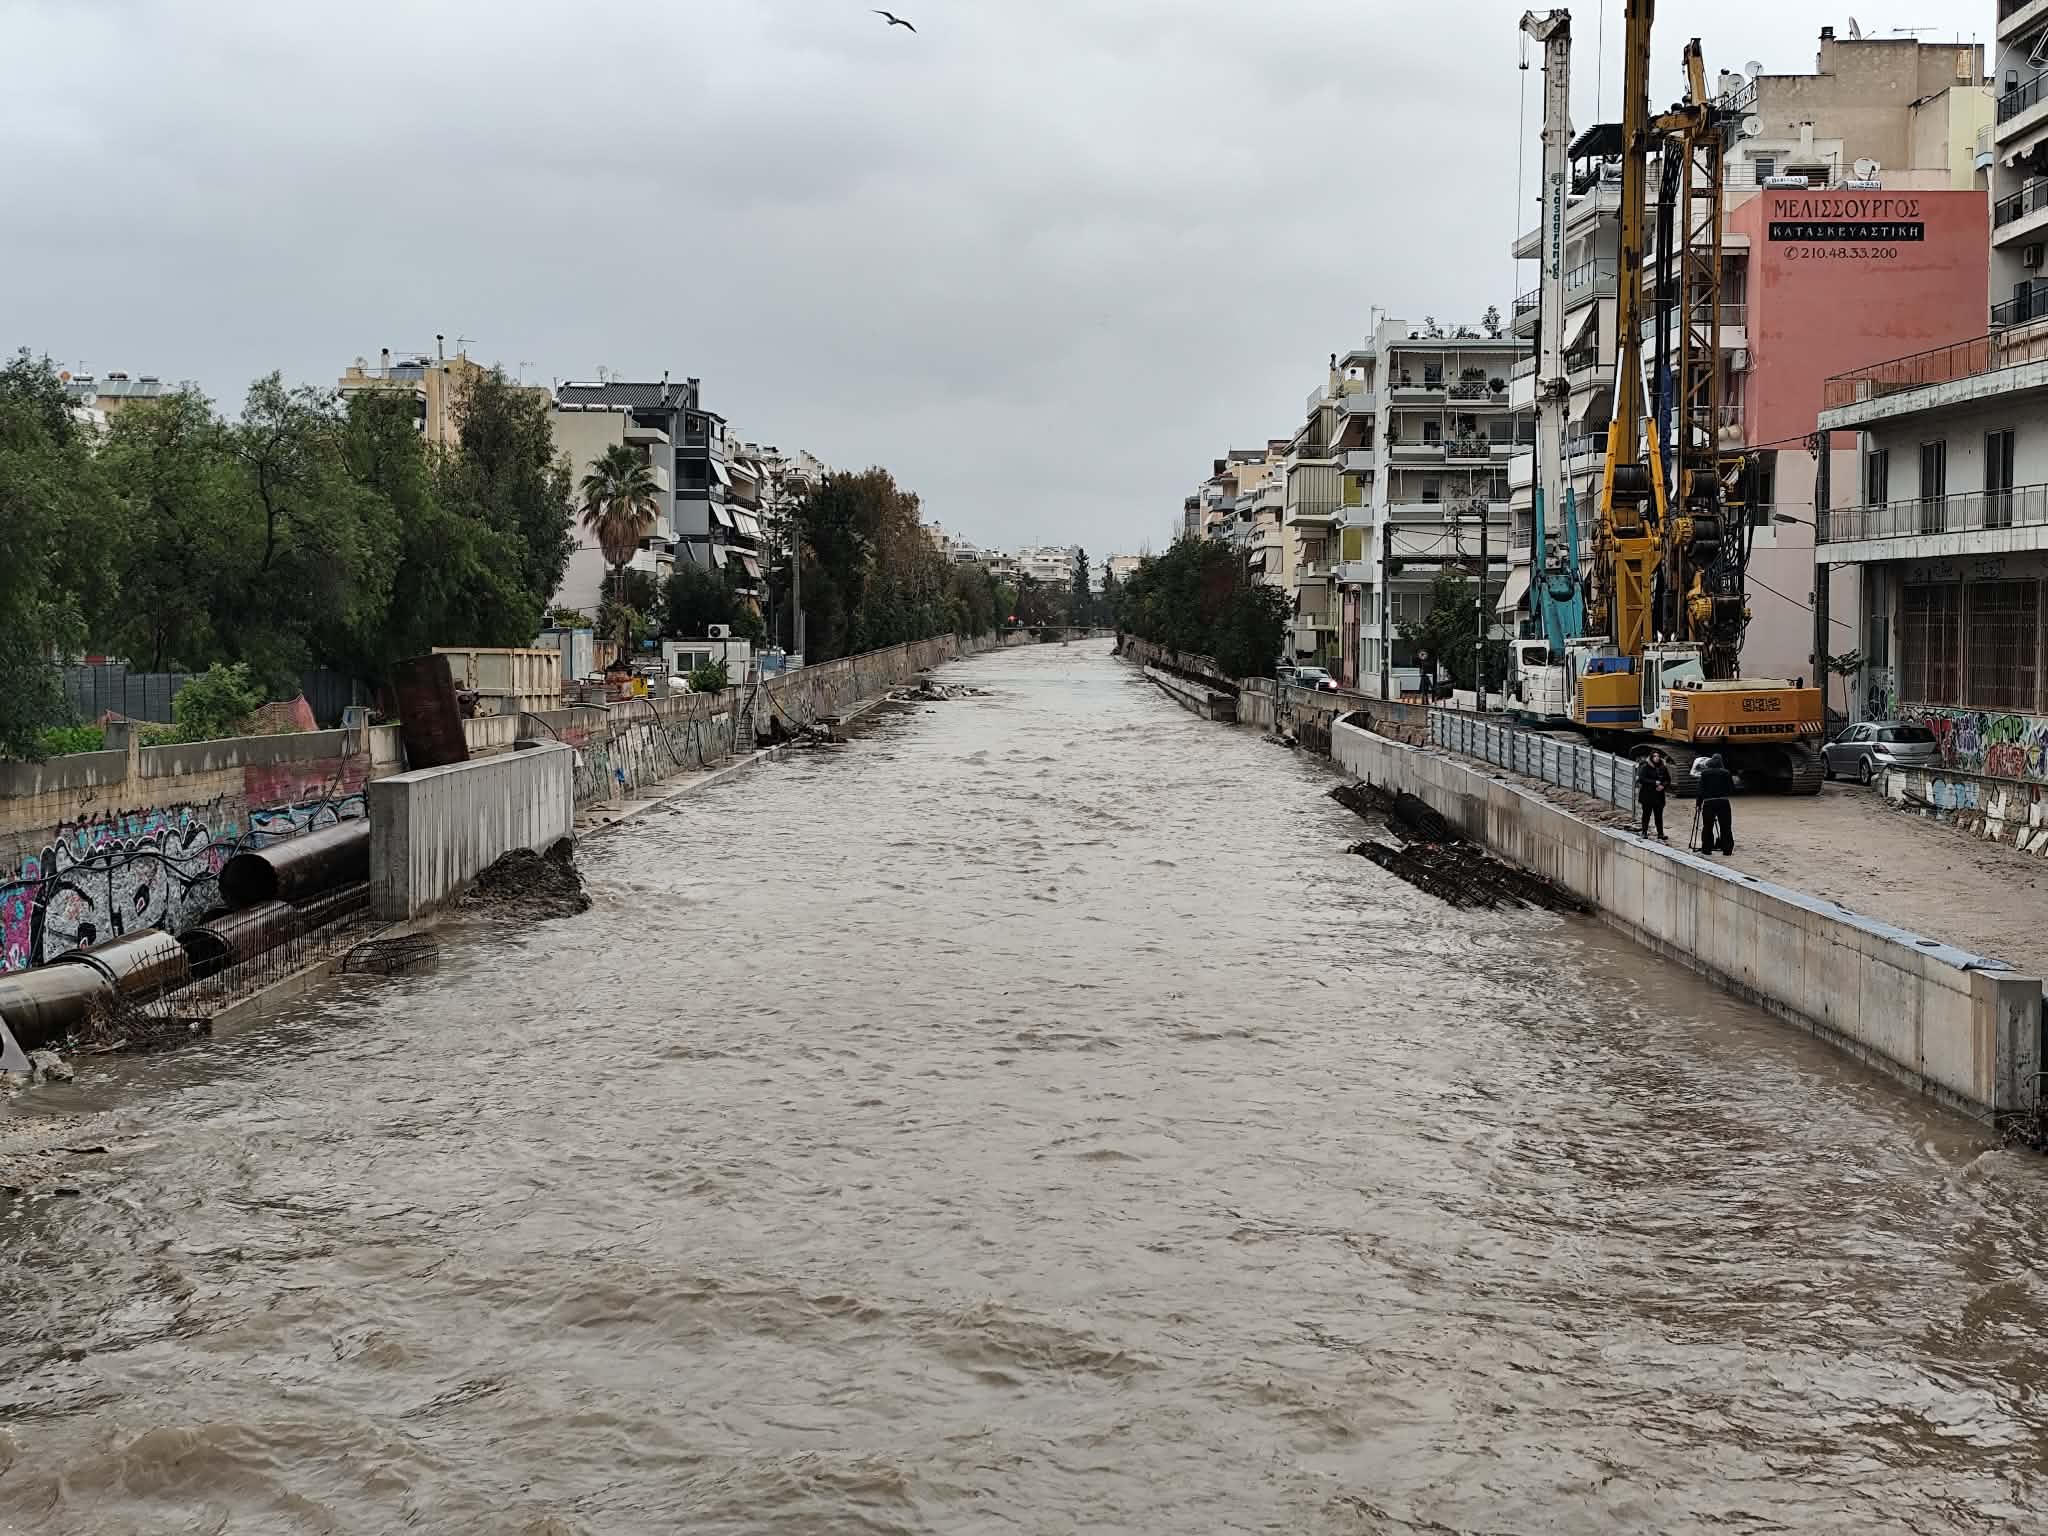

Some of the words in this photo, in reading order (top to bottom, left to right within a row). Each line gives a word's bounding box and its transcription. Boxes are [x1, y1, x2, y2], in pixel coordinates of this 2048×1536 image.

[1774, 199, 1920, 218] ΜΕΛΙΣΣΟΥΡΓΟΣ
[1773, 226, 1919, 238] ΚΑΤΑΣΚΕΥΑΣΤΙΚΗ
[1800, 247, 1898, 259] 210.48.33.200
[1728, 723, 1796, 735] LIEBHERR
